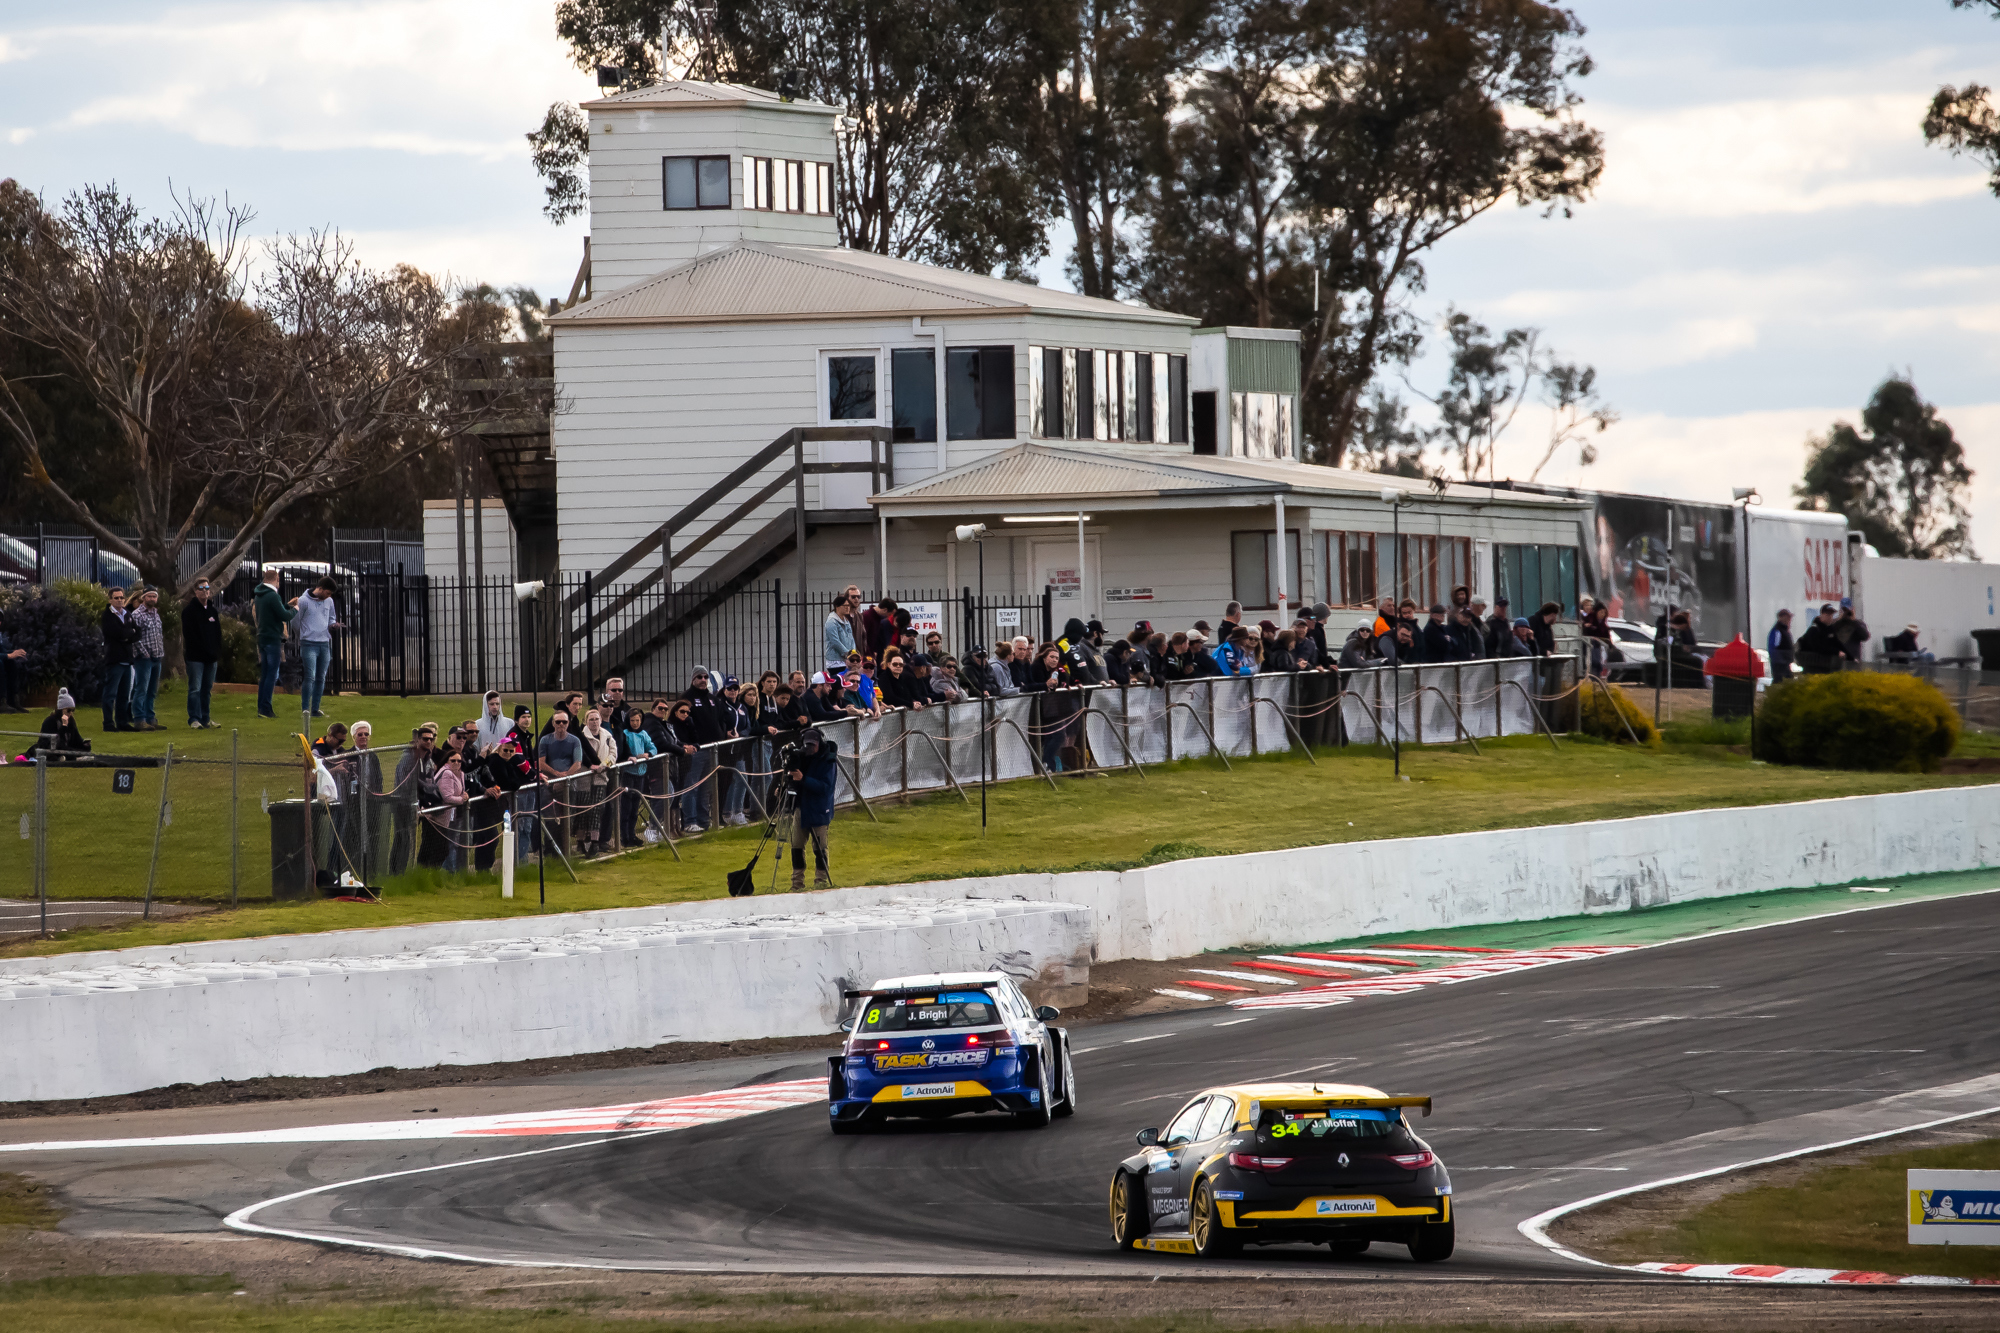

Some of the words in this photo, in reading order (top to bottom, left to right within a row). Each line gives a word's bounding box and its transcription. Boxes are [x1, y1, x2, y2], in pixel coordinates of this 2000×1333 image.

[1804, 537, 1843, 601] SALE
[923, 622, 937, 630] FM
[118, 774, 130, 788] 18
[867, 1008, 880, 1024] 8
[908, 1012, 917, 1021] J.
[919, 1010, 948, 1021] Bright
[916, 1085, 955, 1096] ActronAir
[1271, 1122, 1301, 1138] 34
[1312, 1119, 1322, 1129] J.
[1323, 1119, 1358, 1128] Moffat
[1153, 1198, 1183, 1214] MEGANE
[1333, 1201, 1376, 1212] ActronAir
